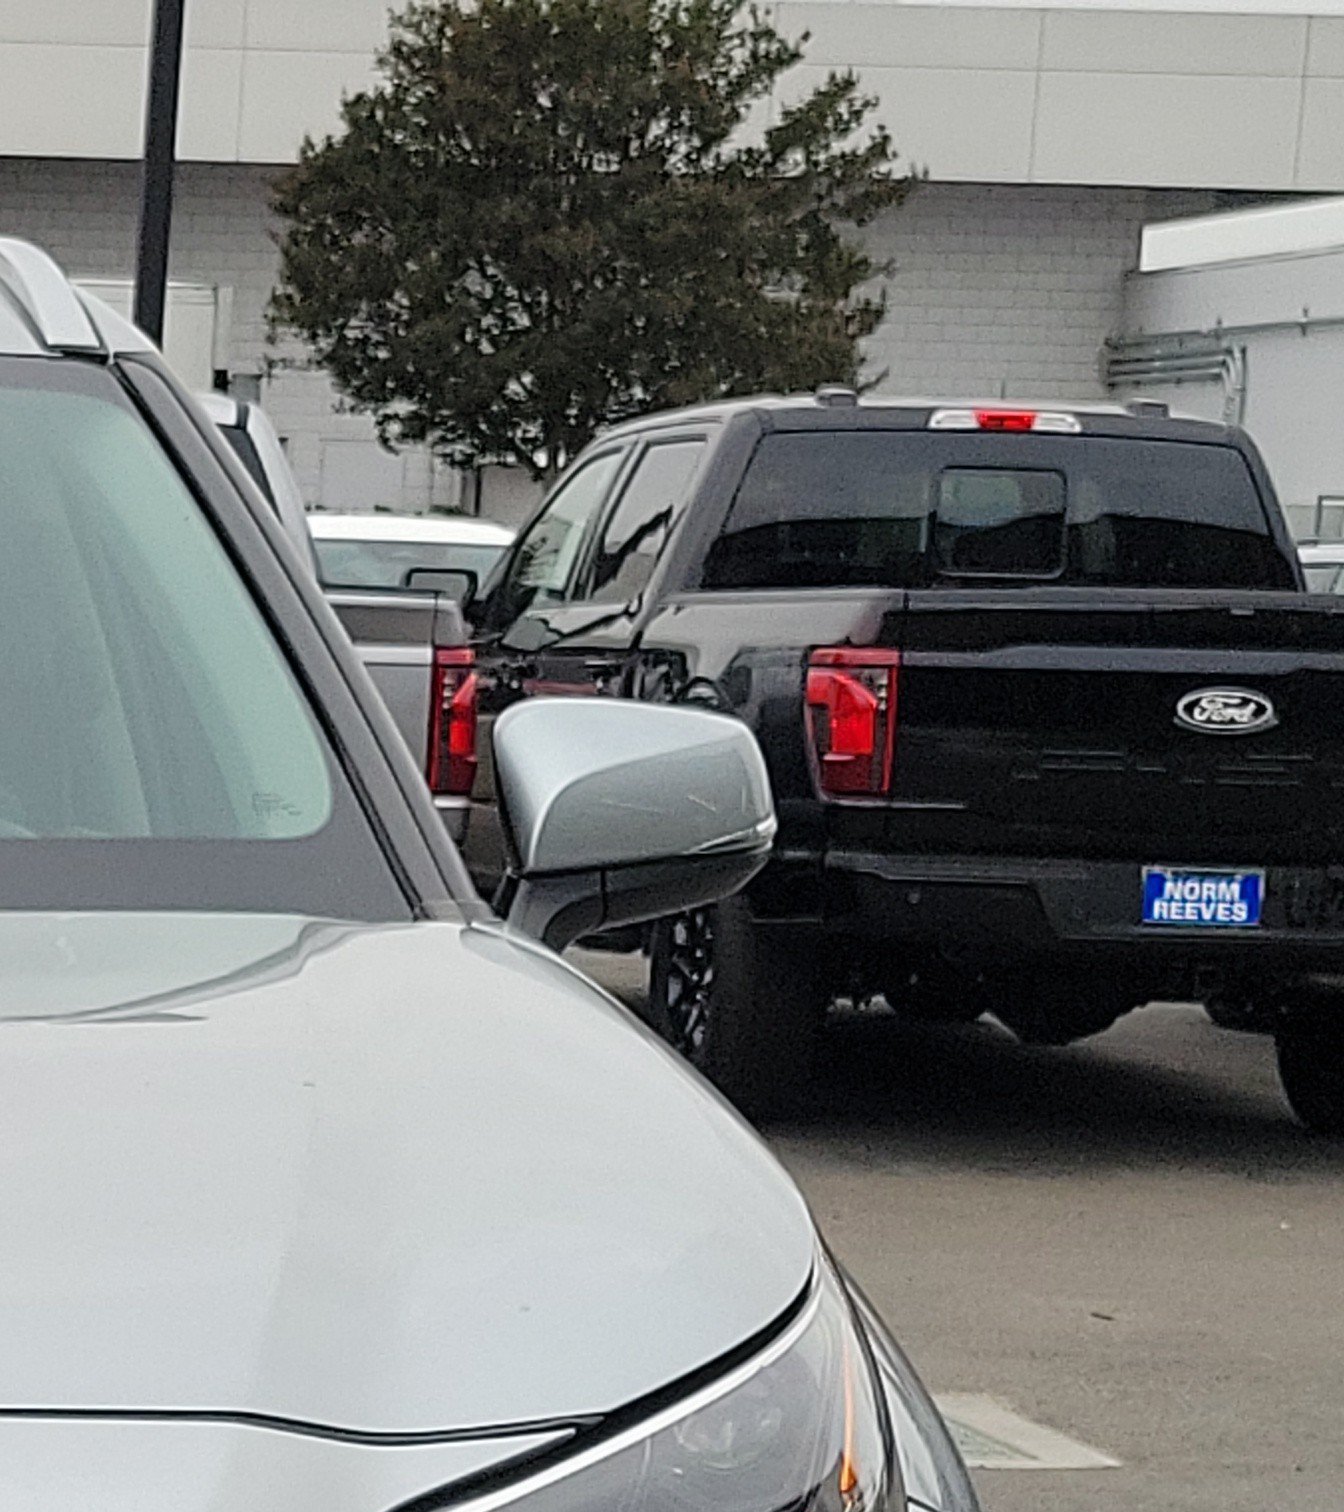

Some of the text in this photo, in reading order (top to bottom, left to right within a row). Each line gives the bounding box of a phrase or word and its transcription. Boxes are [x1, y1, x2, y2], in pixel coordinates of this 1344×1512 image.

[1193, 697, 1257, 723] Ford
[1163, 881, 1241, 901] NORM
[1152, 901, 1249, 922] REEVES
